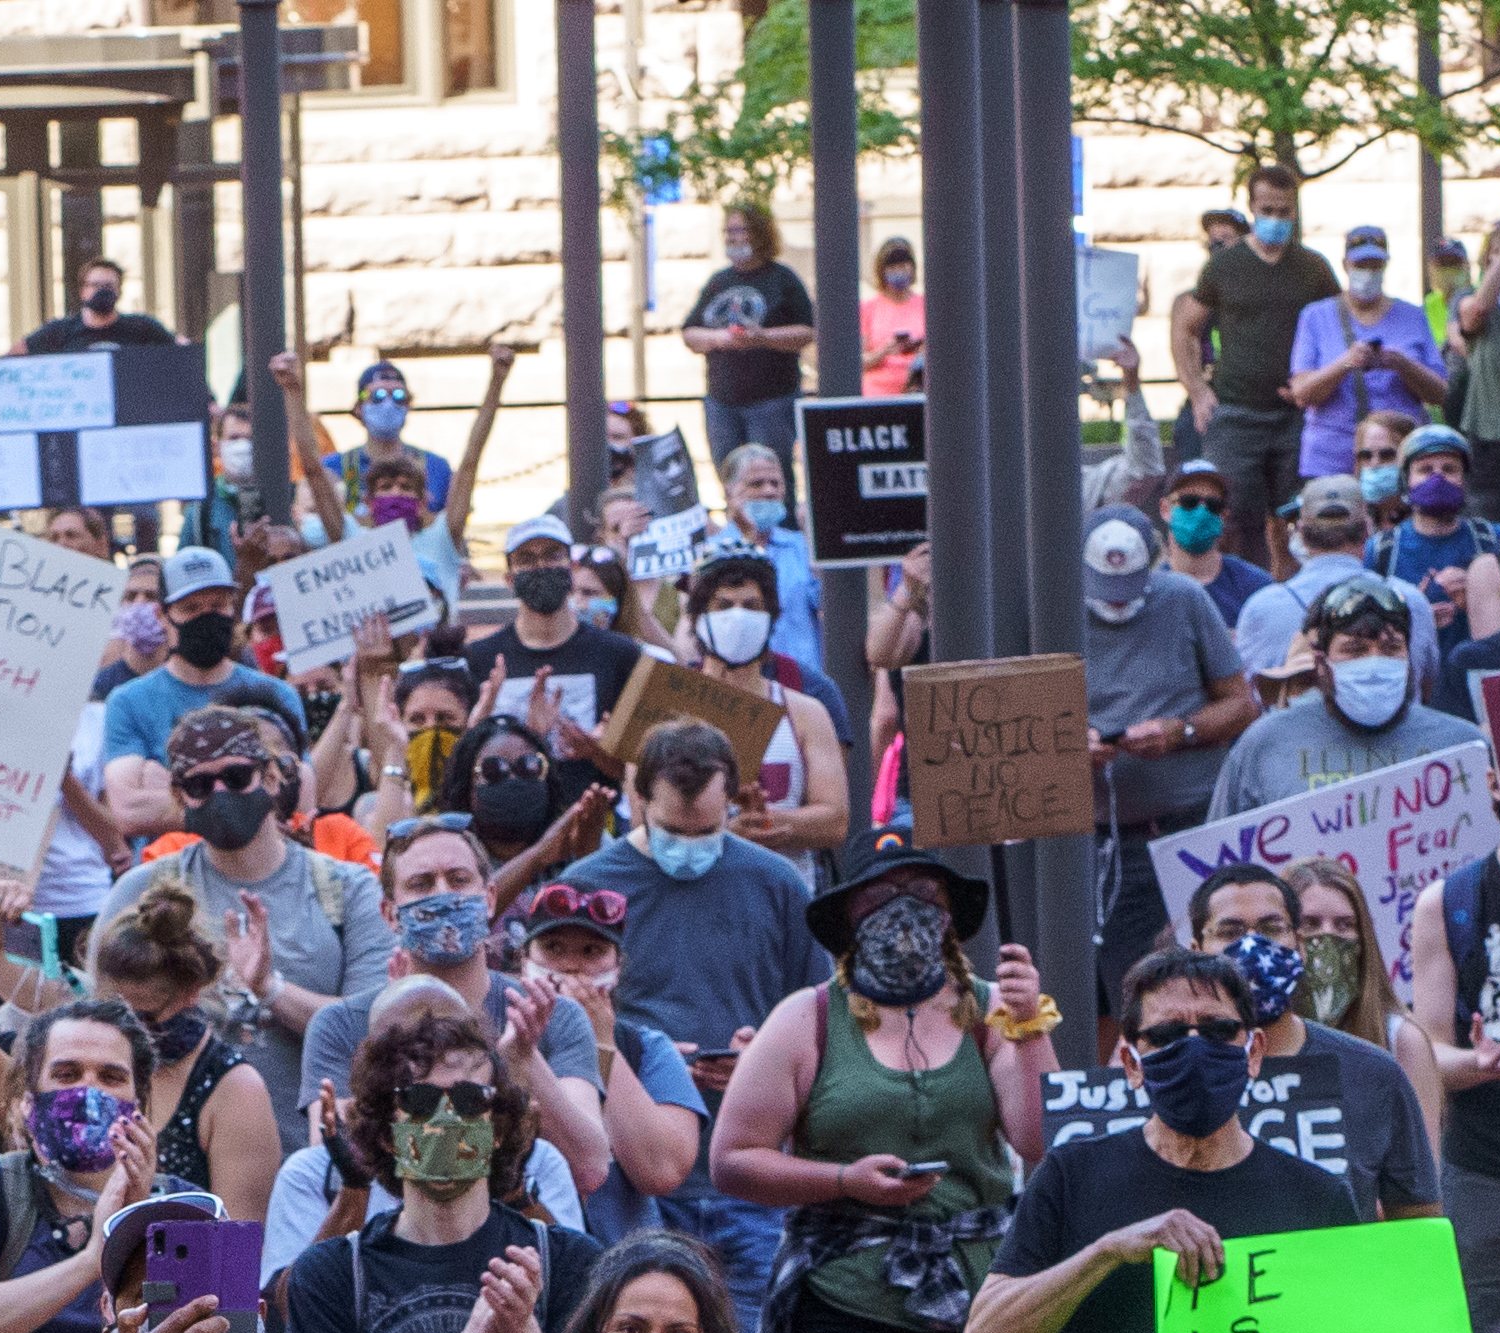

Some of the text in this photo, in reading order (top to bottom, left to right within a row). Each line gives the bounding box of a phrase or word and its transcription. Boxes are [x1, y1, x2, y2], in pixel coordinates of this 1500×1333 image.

[825, 424, 908, 454] BLACK
[297, 543, 398, 596] ENOUGH
[333, 583, 356, 604] IS
[928, 680, 999, 732] NO
[924, 711, 1086, 766] JUSTICE
[969, 758, 1020, 791] NO
[936, 785, 1069, 840] PEACE
[1176, 811, 1294, 880] We
[1310, 789, 1379, 842] will
[1387, 811, 1474, 872] Fear
